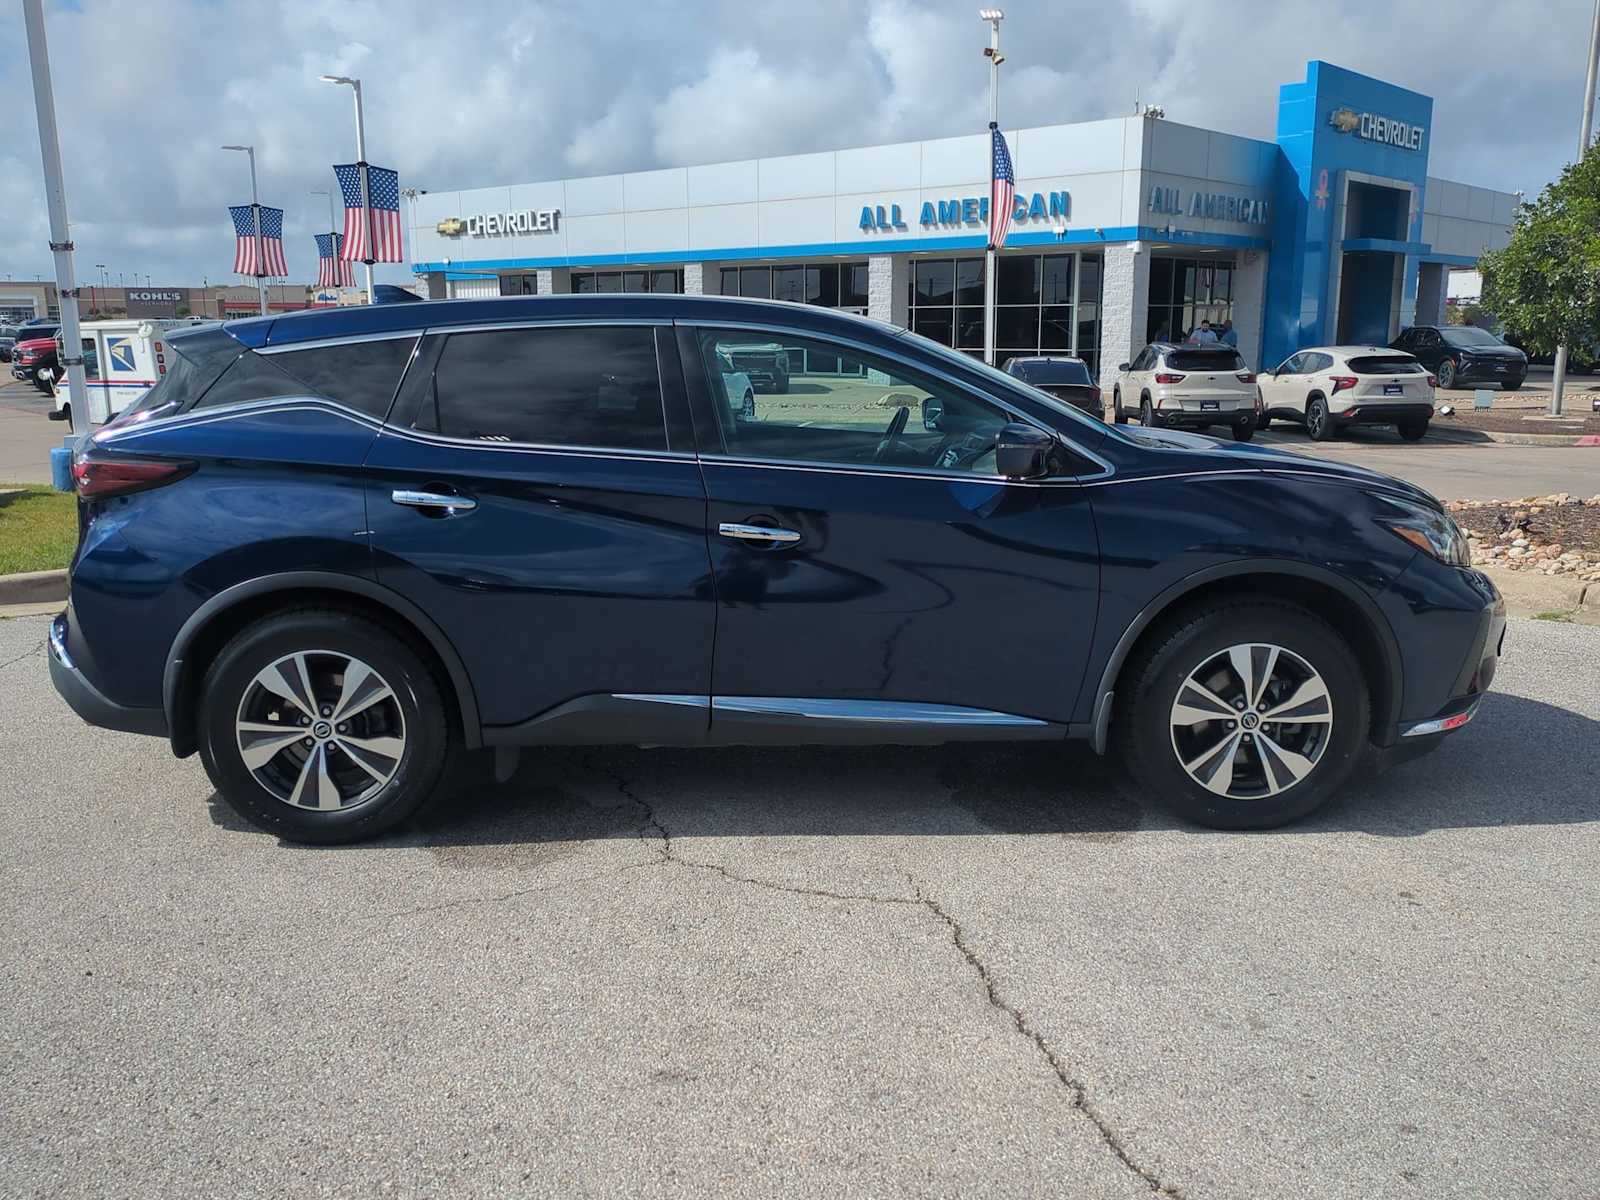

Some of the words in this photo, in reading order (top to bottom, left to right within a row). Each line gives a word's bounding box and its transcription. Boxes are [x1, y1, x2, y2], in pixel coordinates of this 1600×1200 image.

[1360, 112, 1425, 151] CHEVROLET
[859, 204, 906, 230] ALL
[919, 191, 1072, 226] AMECAN
[1150, 186, 1183, 215] ALL
[466, 208, 559, 236] CHEVROLET
[129, 292, 182, 301] KOHL'S
